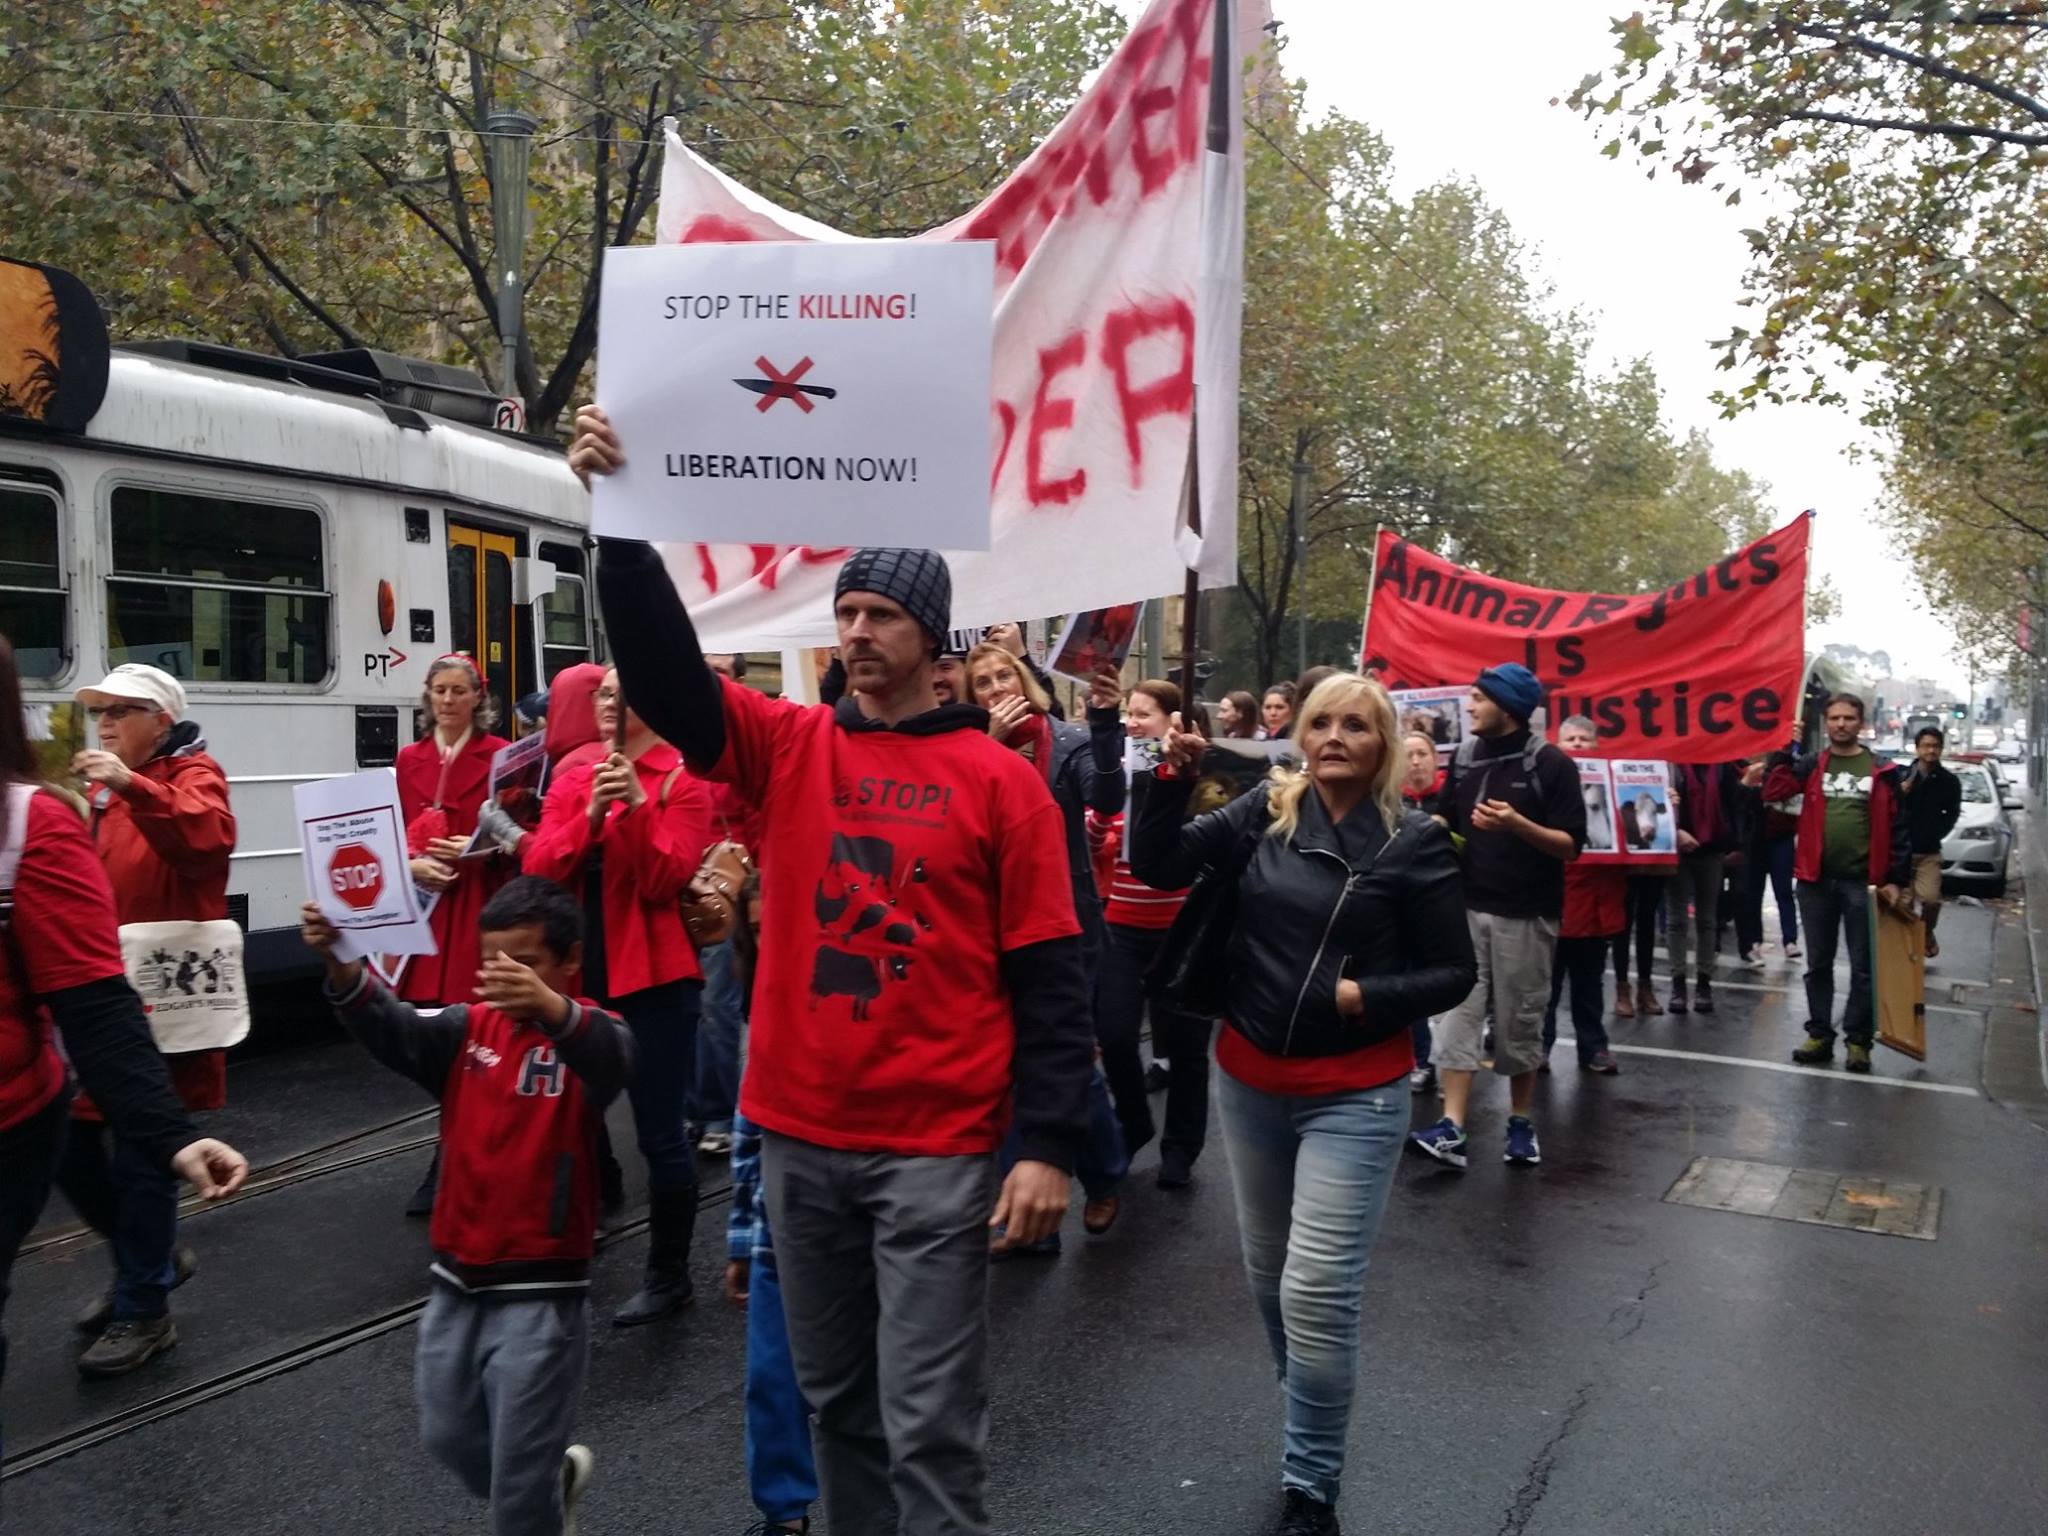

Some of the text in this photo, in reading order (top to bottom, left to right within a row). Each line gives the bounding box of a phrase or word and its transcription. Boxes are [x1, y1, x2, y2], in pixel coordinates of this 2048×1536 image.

[663, 293, 917, 320] STOP THE KILLING!
[665, 453, 918, 482] LIBERATION NOW!
[1374, 541, 1565, 630] Animal
[857, 776, 953, 816] STOP!
[331, 862, 380, 892] STOP
[515, 1046, 567, 1097] H
